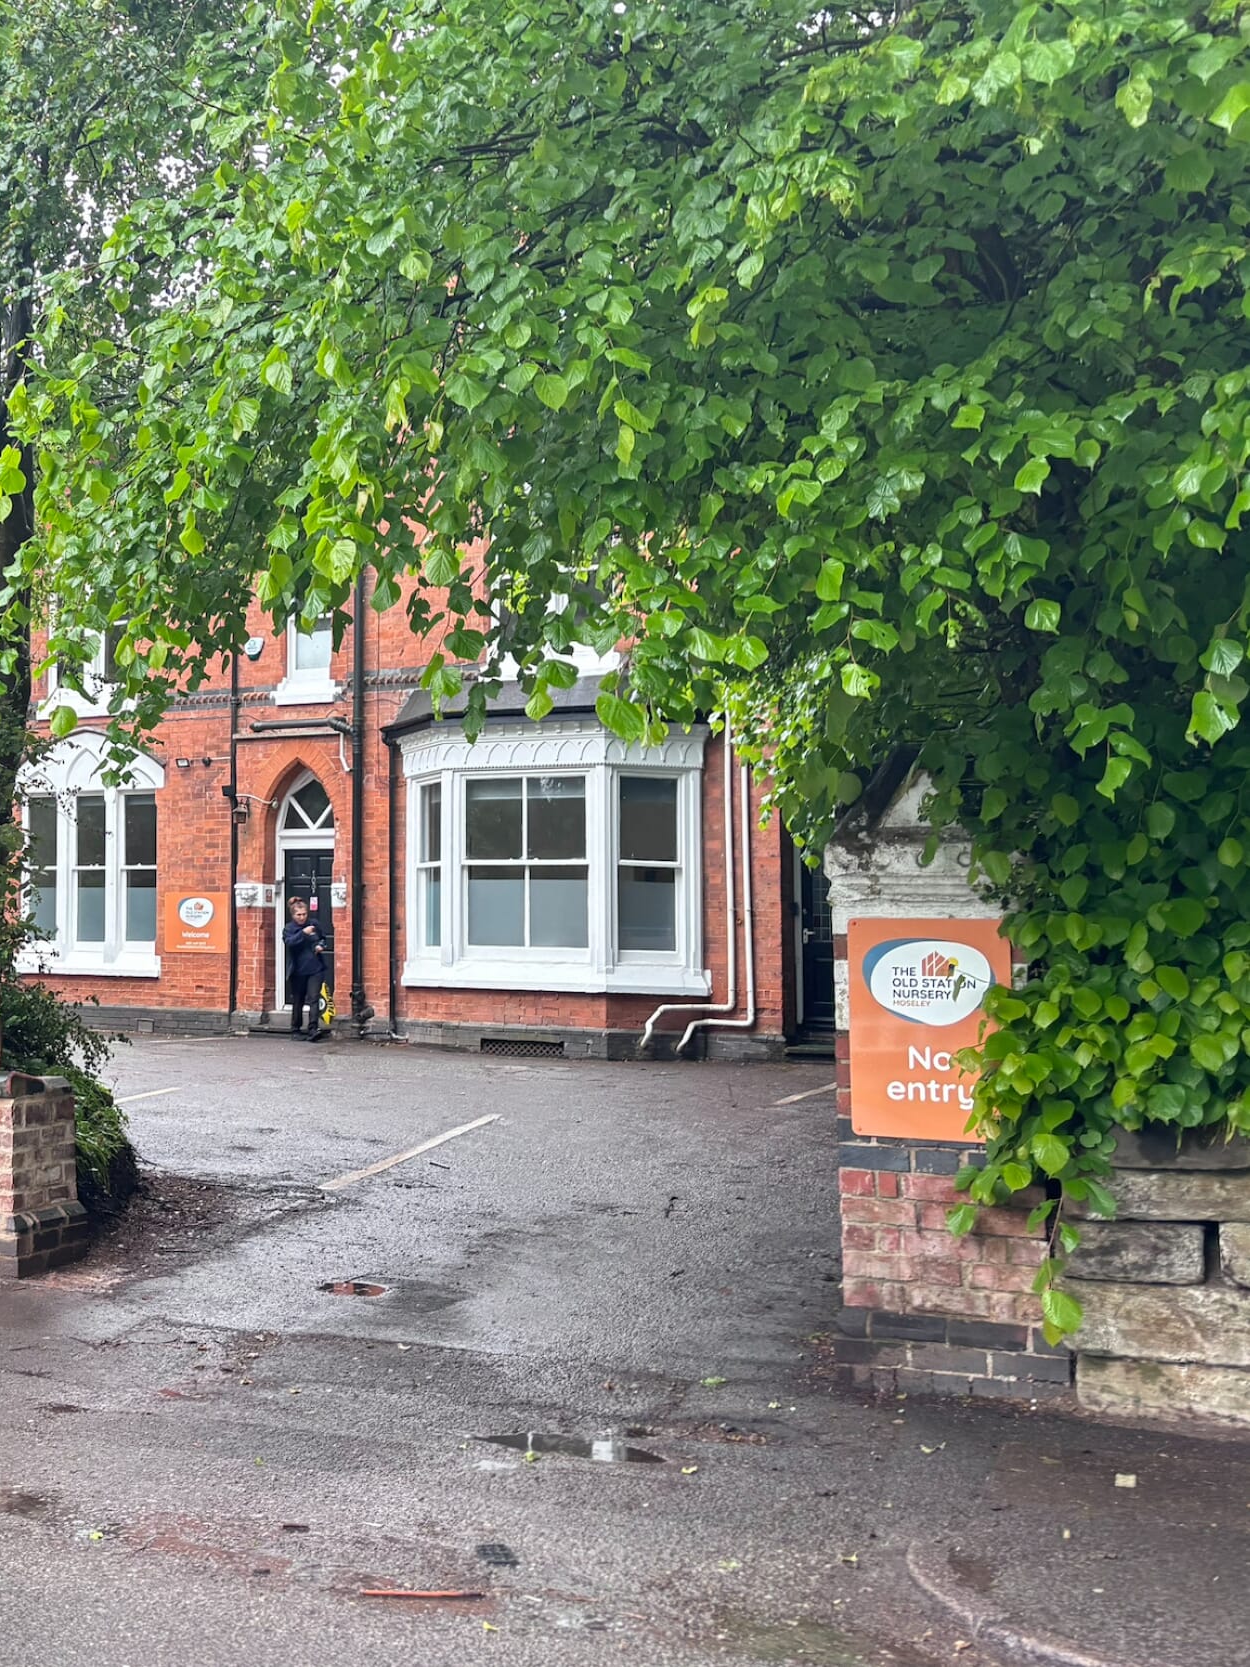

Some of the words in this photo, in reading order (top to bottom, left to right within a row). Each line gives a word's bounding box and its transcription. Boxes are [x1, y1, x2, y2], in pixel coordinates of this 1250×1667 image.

[892, 966, 916, 977] THE
[892, 977, 918, 988] OLD
[921, 978, 976, 989] STATON
[892, 989, 951, 1000] NURSERY
[908, 1045, 952, 1072] No
[886, 1079, 975, 1111] entry
